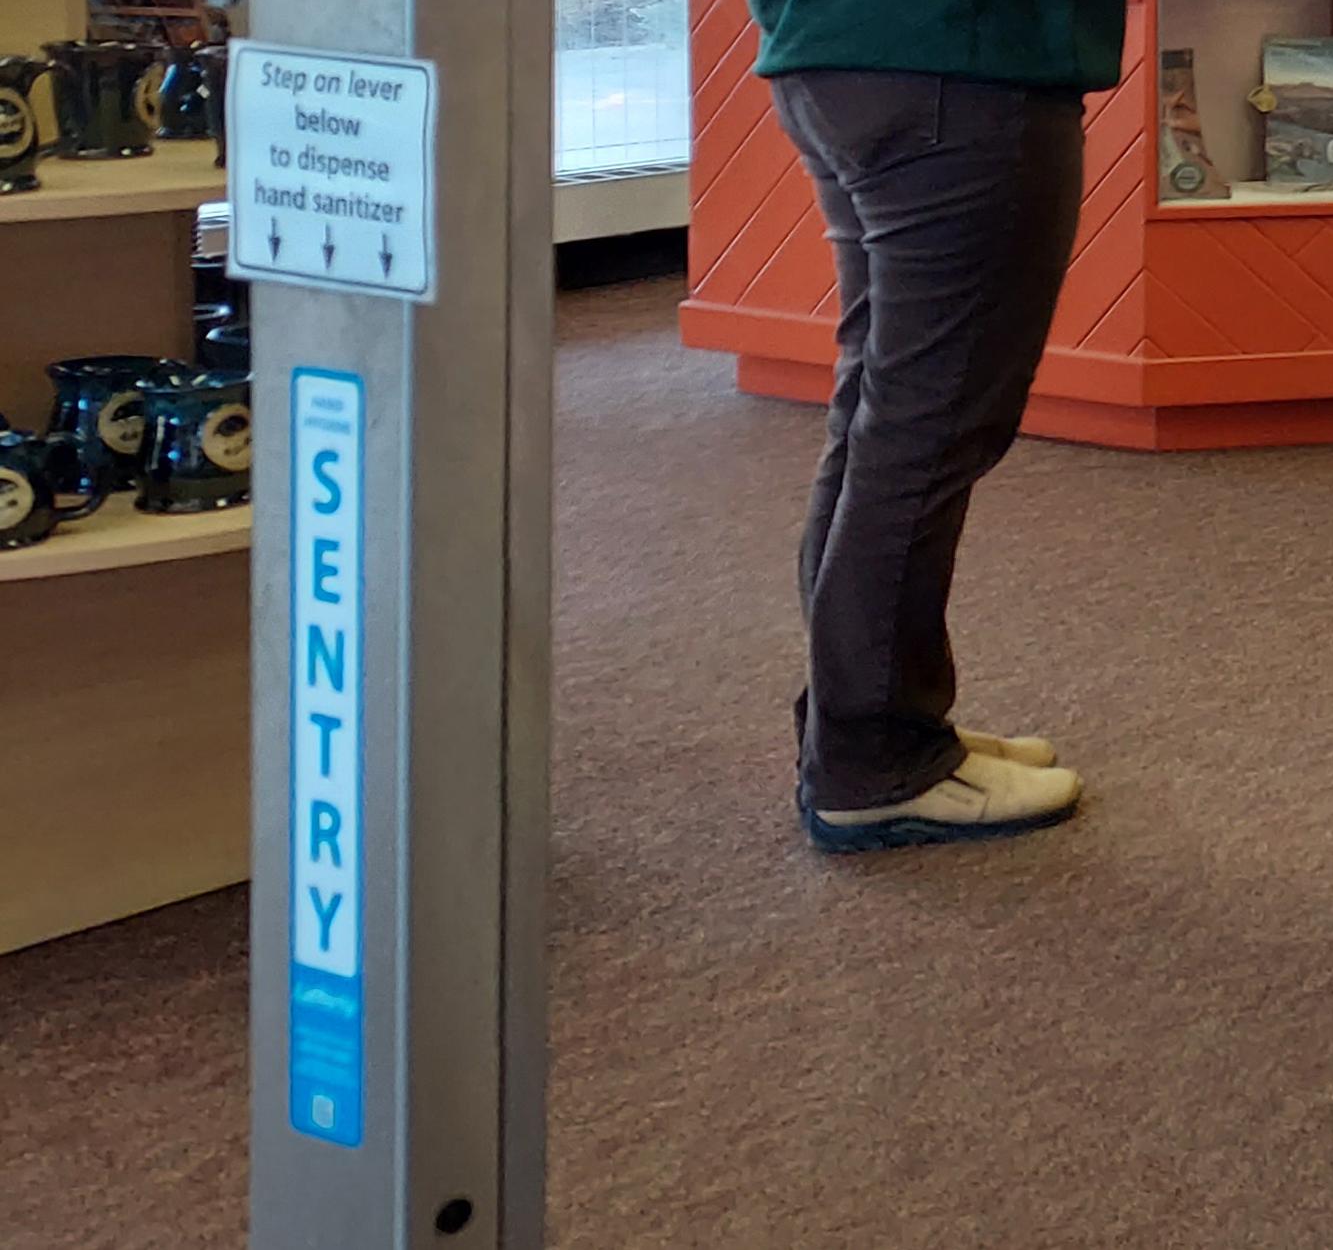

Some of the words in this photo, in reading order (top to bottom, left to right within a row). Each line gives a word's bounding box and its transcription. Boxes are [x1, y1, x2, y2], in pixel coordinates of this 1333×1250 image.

[261, 61, 307, 96] Step
[313, 74, 343, 94] on
[348, 70, 404, 102] lever
[294, 103, 362, 138] below
[269, 145, 291, 169] to
[297, 143, 391, 182] dispense
[254, 177, 306, 212] hand
[312, 191, 404, 224] sanitizer
[307, 449, 345, 952] SENTRY
